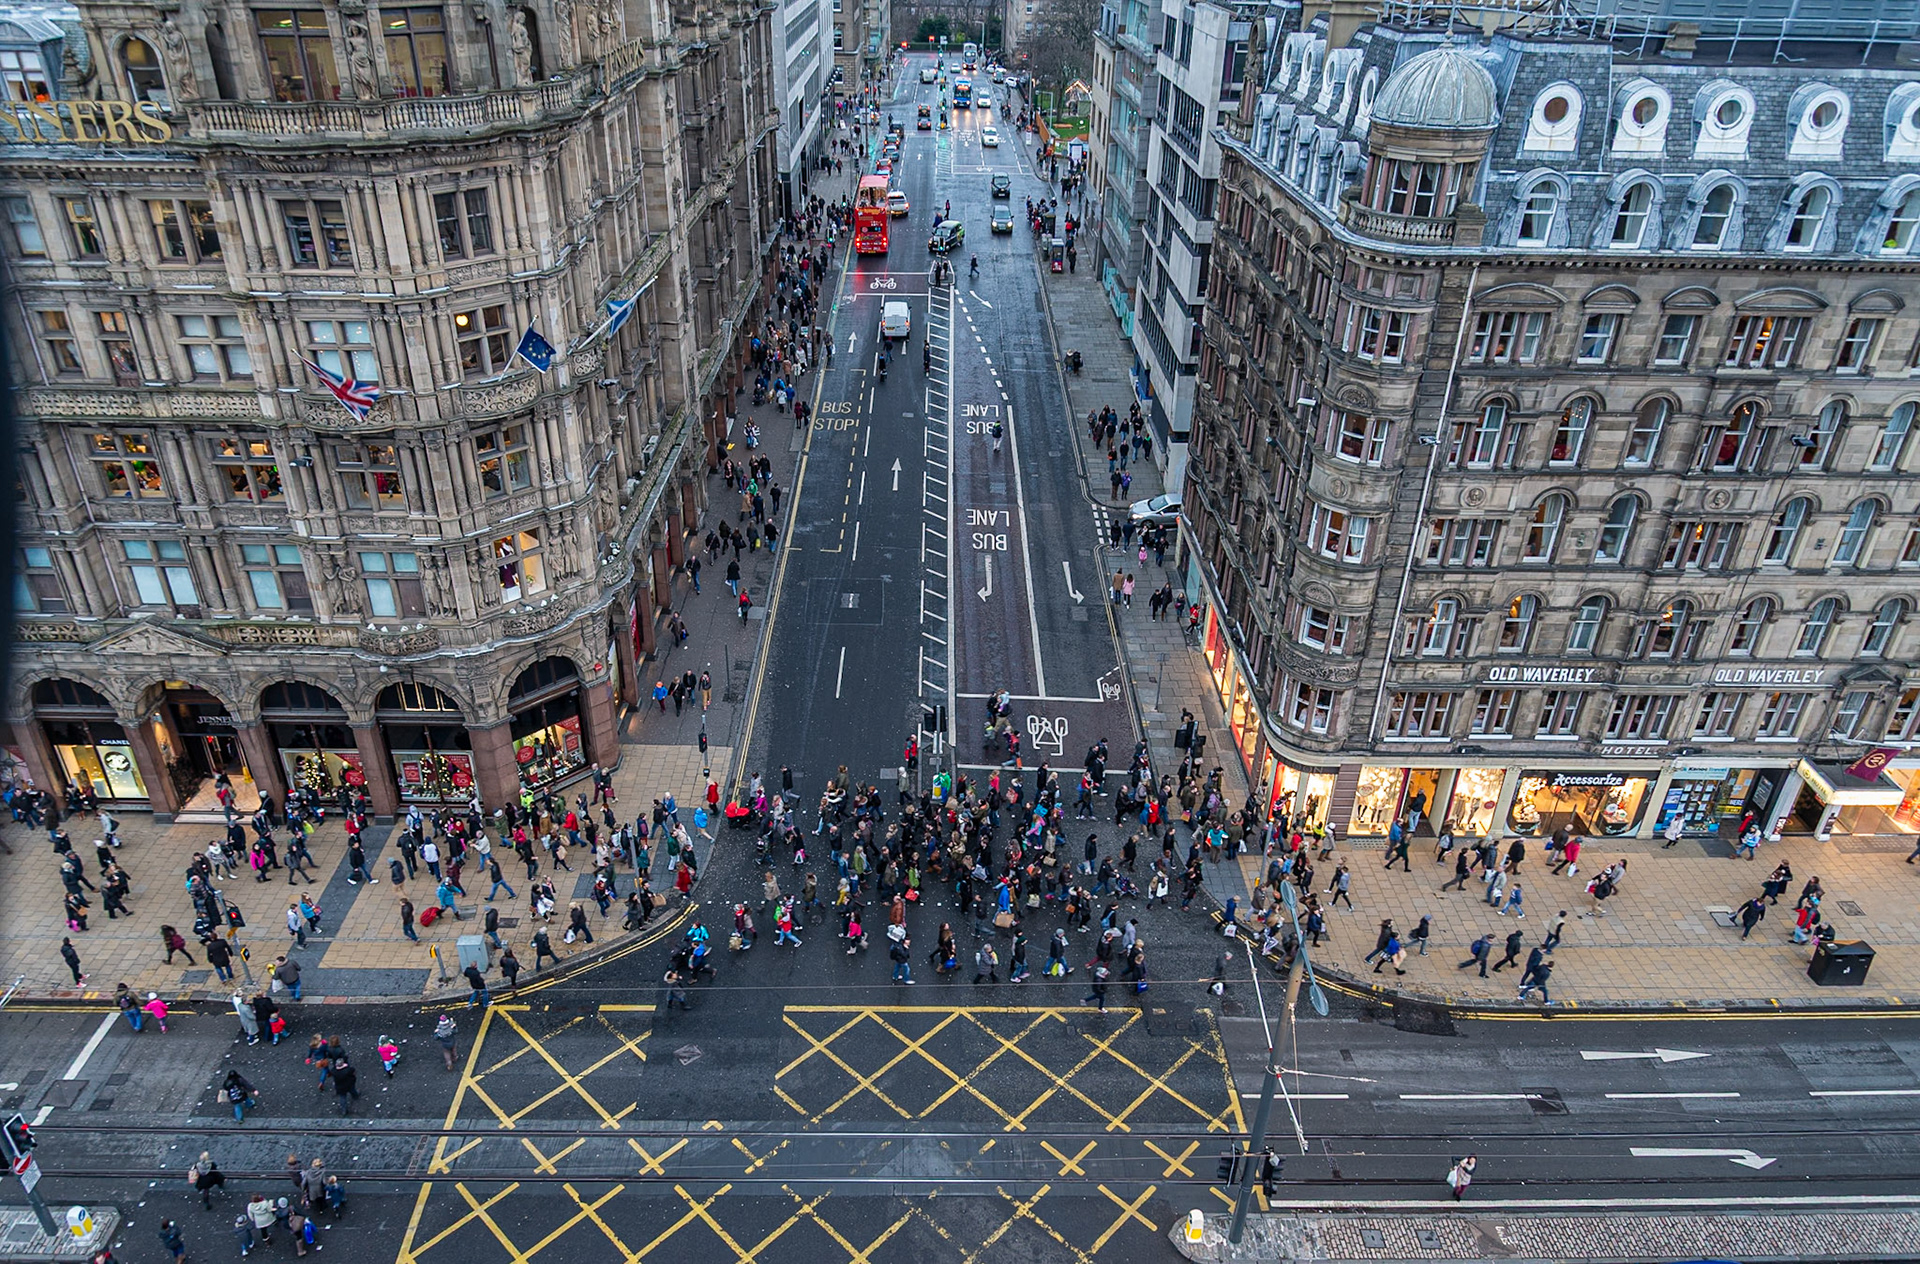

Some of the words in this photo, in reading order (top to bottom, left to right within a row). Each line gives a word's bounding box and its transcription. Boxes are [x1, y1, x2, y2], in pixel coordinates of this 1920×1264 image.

[821, 401, 852, 414] BUS
[961, 404, 999, 417] LANE
[814, 418, 854, 431] STOP
[966, 508, 1010, 527] LANE
[972, 533, 1008, 551] BUS
[1489, 668, 1517, 681] OLD
[1522, 668, 1595, 682] WAVERLEY
[1715, 669, 1744, 682] OLD
[1748, 670, 1825, 683] WAVERLEY
[1551, 773, 1624, 786] Accessorize
